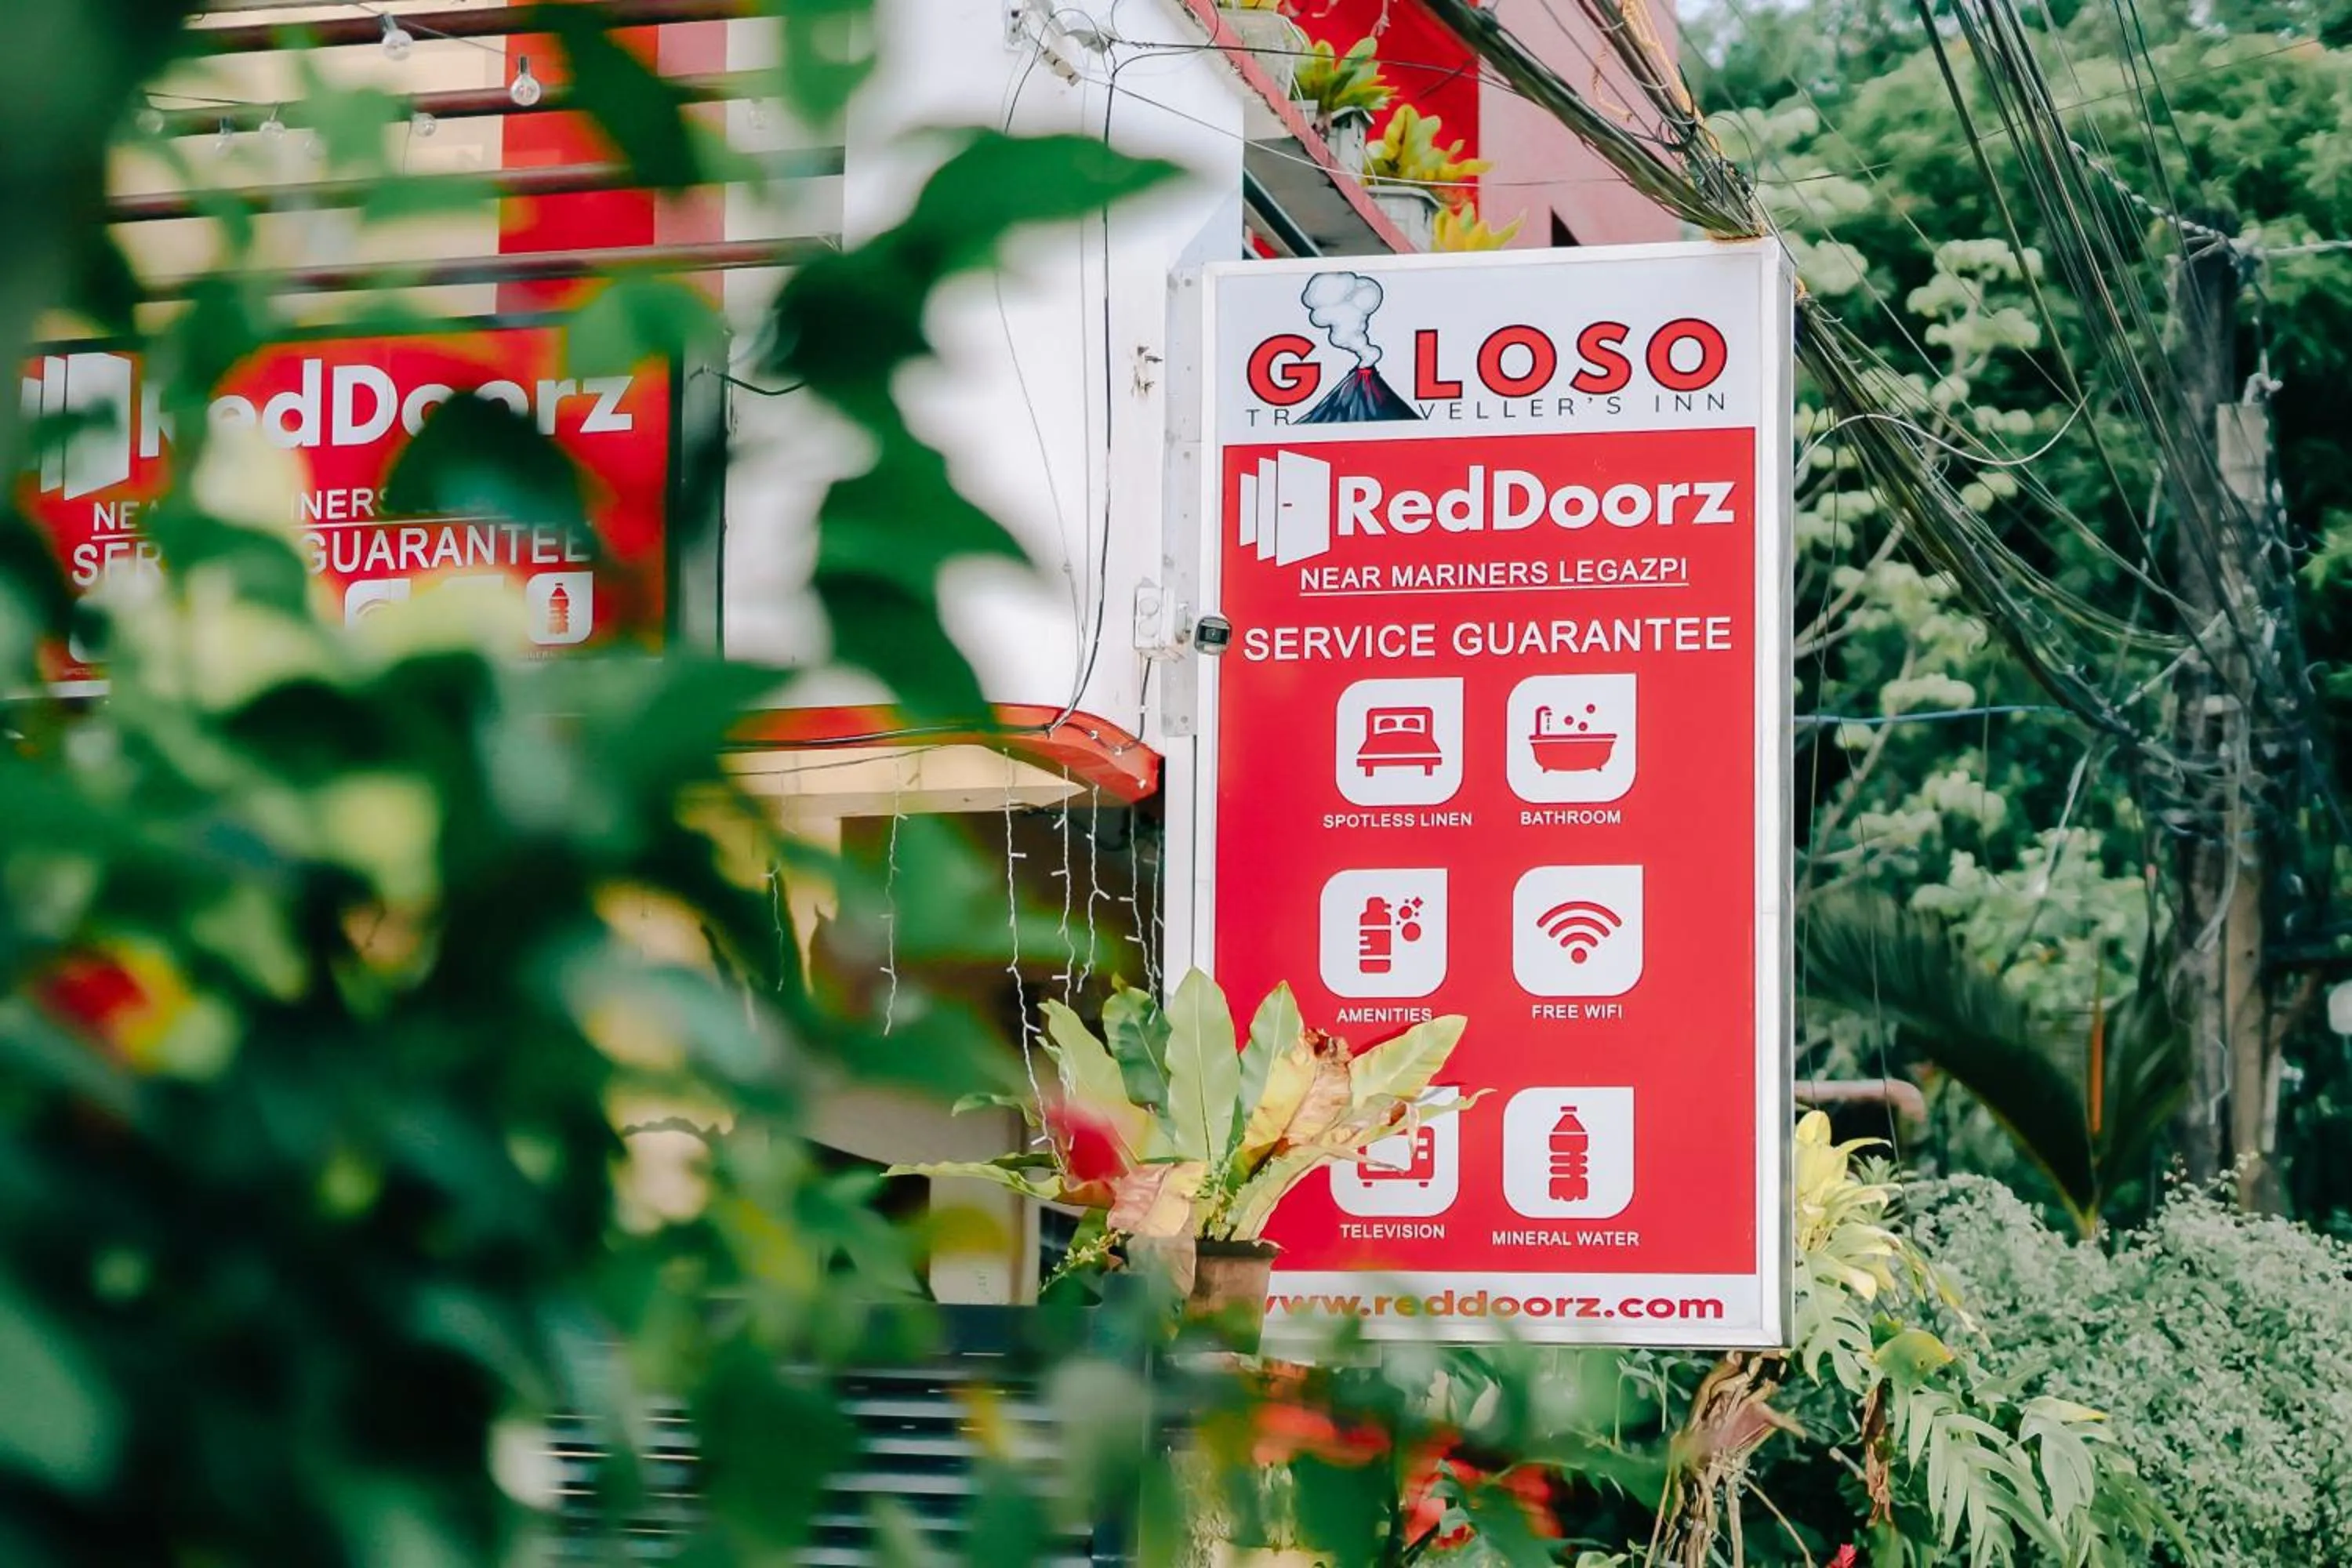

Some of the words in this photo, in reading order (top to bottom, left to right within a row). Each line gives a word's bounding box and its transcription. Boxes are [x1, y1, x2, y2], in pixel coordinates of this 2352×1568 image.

[1654, 393, 1725, 412] INN
[1338, 465, 1735, 536] RedDoorz
[1300, 566, 1381, 590] NEAR
[1390, 561, 1549, 588] MARINERS
[1559, 557, 1688, 584] LEGAZPI
[1243, 623, 1436, 661] SERVICE
[1452, 616, 1733, 655] GUARANTEE
[1323, 812, 1415, 829] SPOTLESS
[1420, 811, 1472, 827] LINEN
[1519, 810, 1621, 826] BATHROOM
[1336, 1007, 1433, 1024] AMENITIES
[1531, 1004, 1578, 1018] FREE
[1584, 1004, 1623, 1018] WIFI
[1340, 1223, 1446, 1240] TELEVISION
[1492, 1231, 1571, 1247] MINERAL
[1576, 1231, 1639, 1247] WATER
